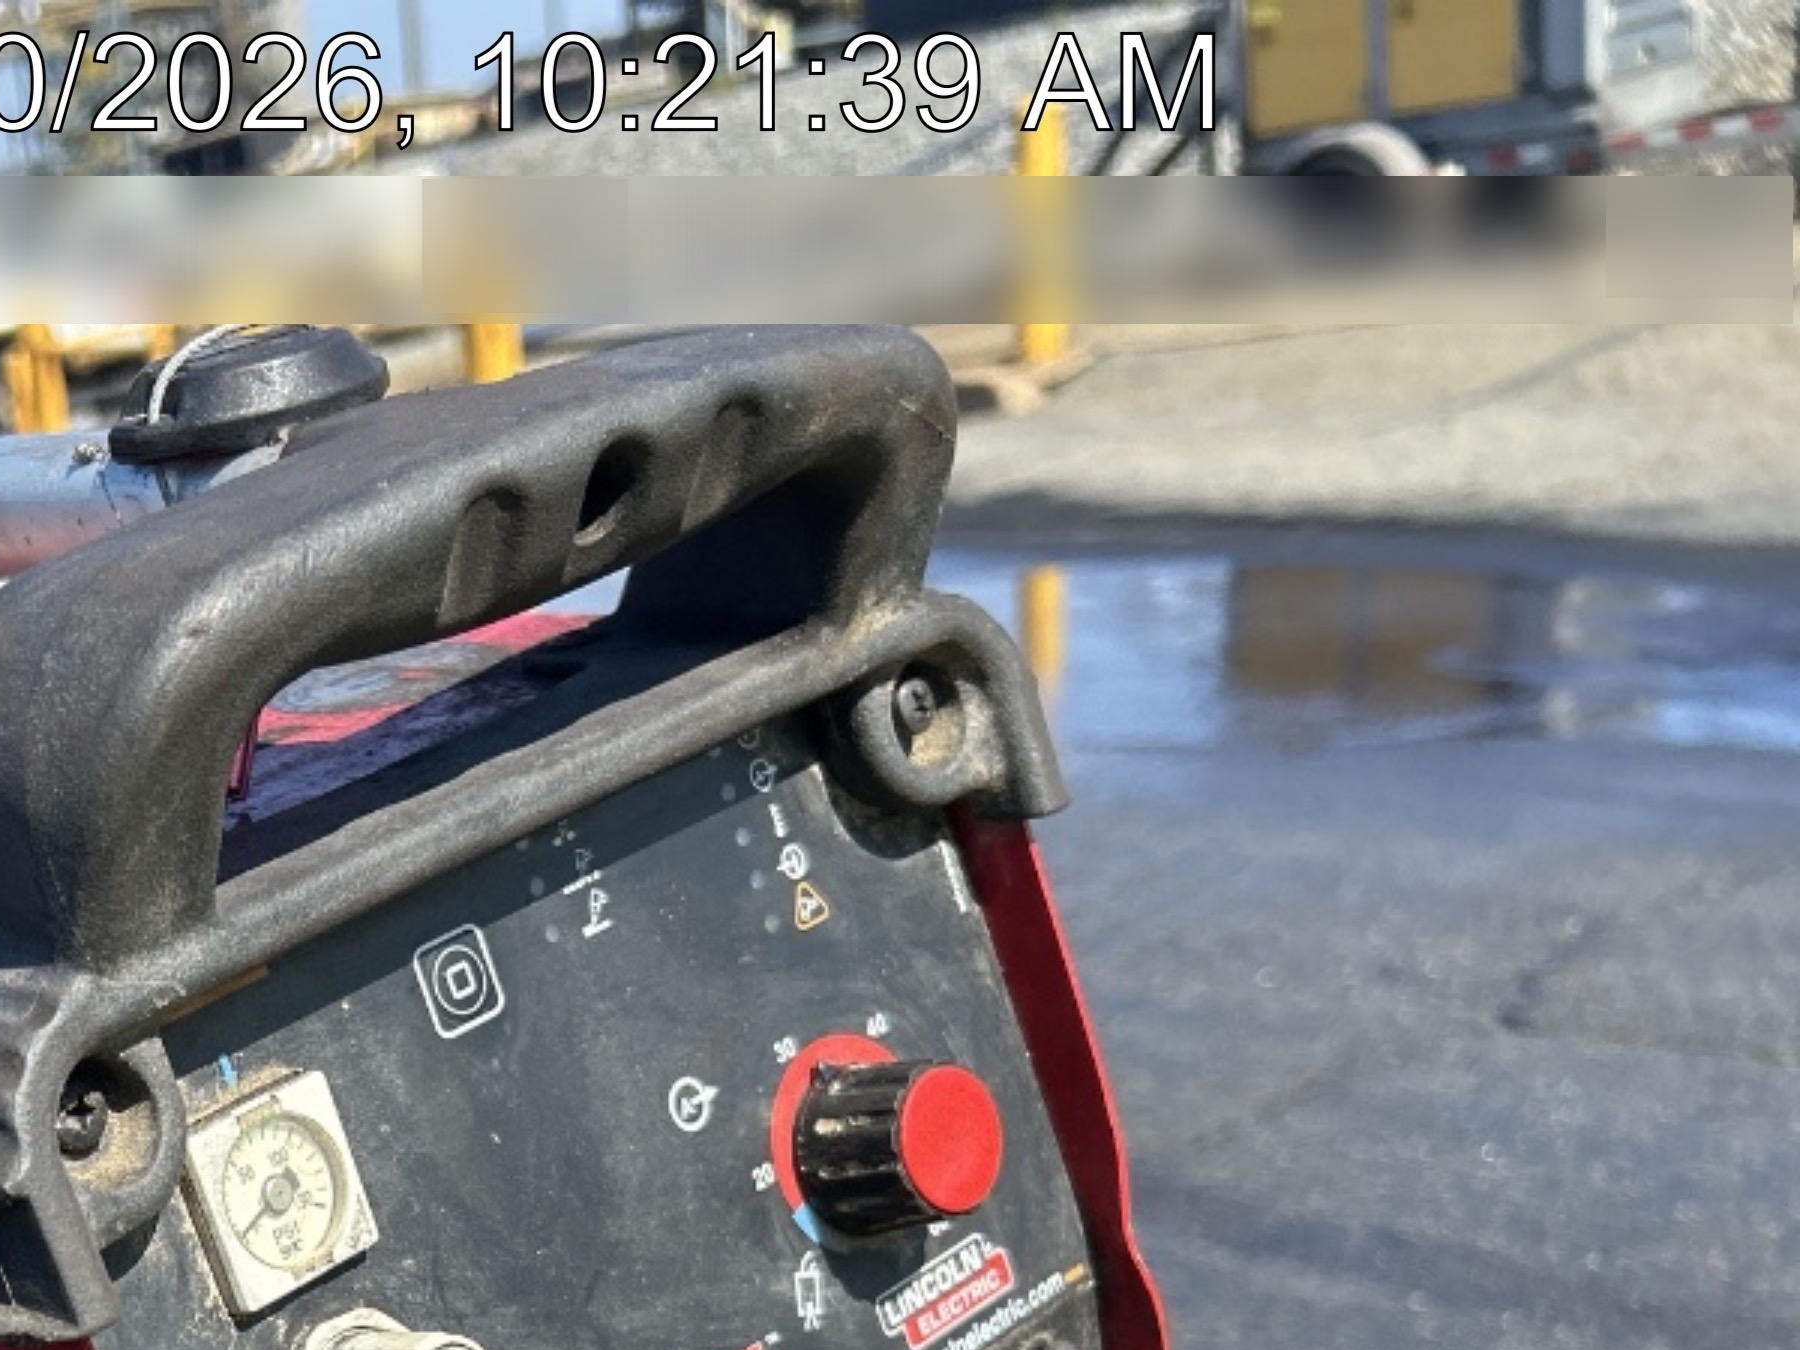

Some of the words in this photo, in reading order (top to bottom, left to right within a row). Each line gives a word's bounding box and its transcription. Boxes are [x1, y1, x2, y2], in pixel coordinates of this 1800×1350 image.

[751, 1162, 776, 1192] 20
[883, 1243, 983, 1325] LINCOLN
[917, 1267, 1001, 1336] ELECTRIC
